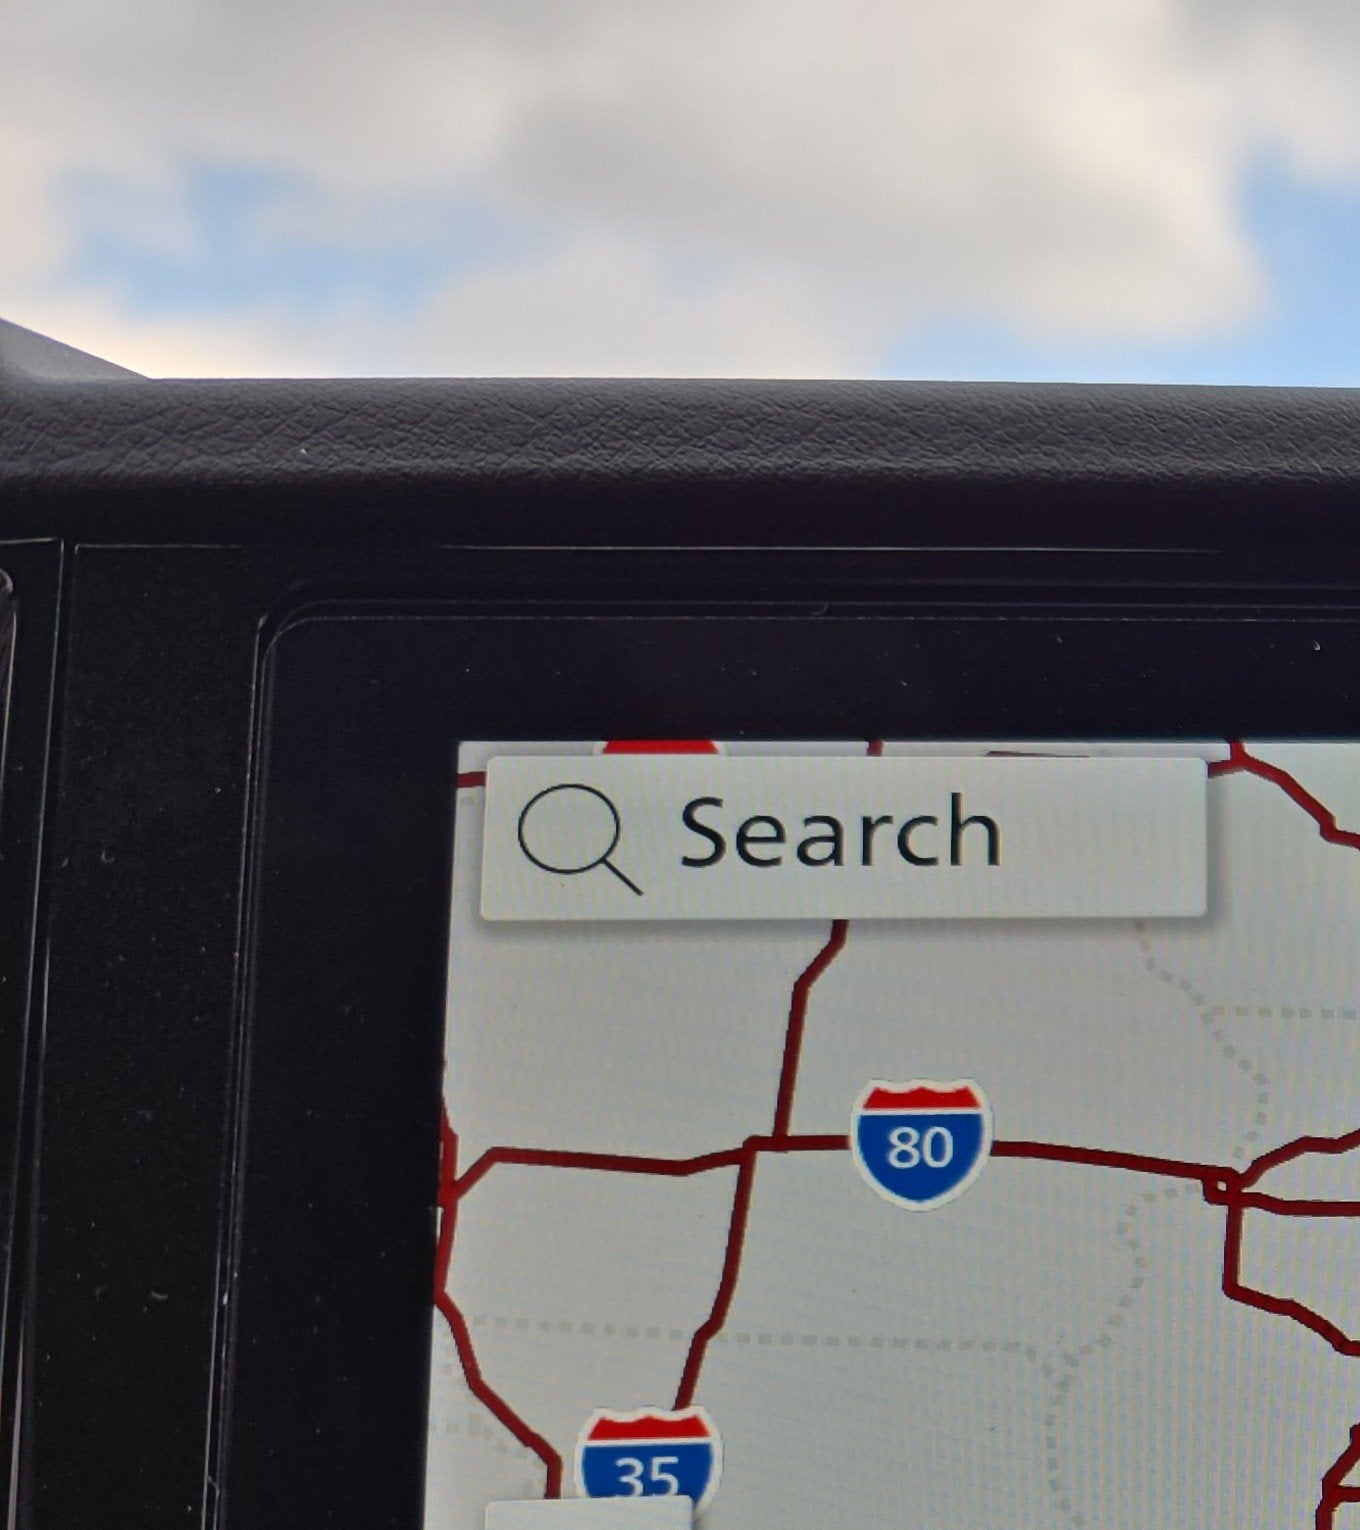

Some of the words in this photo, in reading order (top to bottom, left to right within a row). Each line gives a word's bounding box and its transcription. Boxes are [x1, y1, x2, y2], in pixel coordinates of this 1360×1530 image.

[680, 791, 1001, 869] Search
[886, 1126, 954, 1171] 80
[615, 1456, 679, 1496] 35
